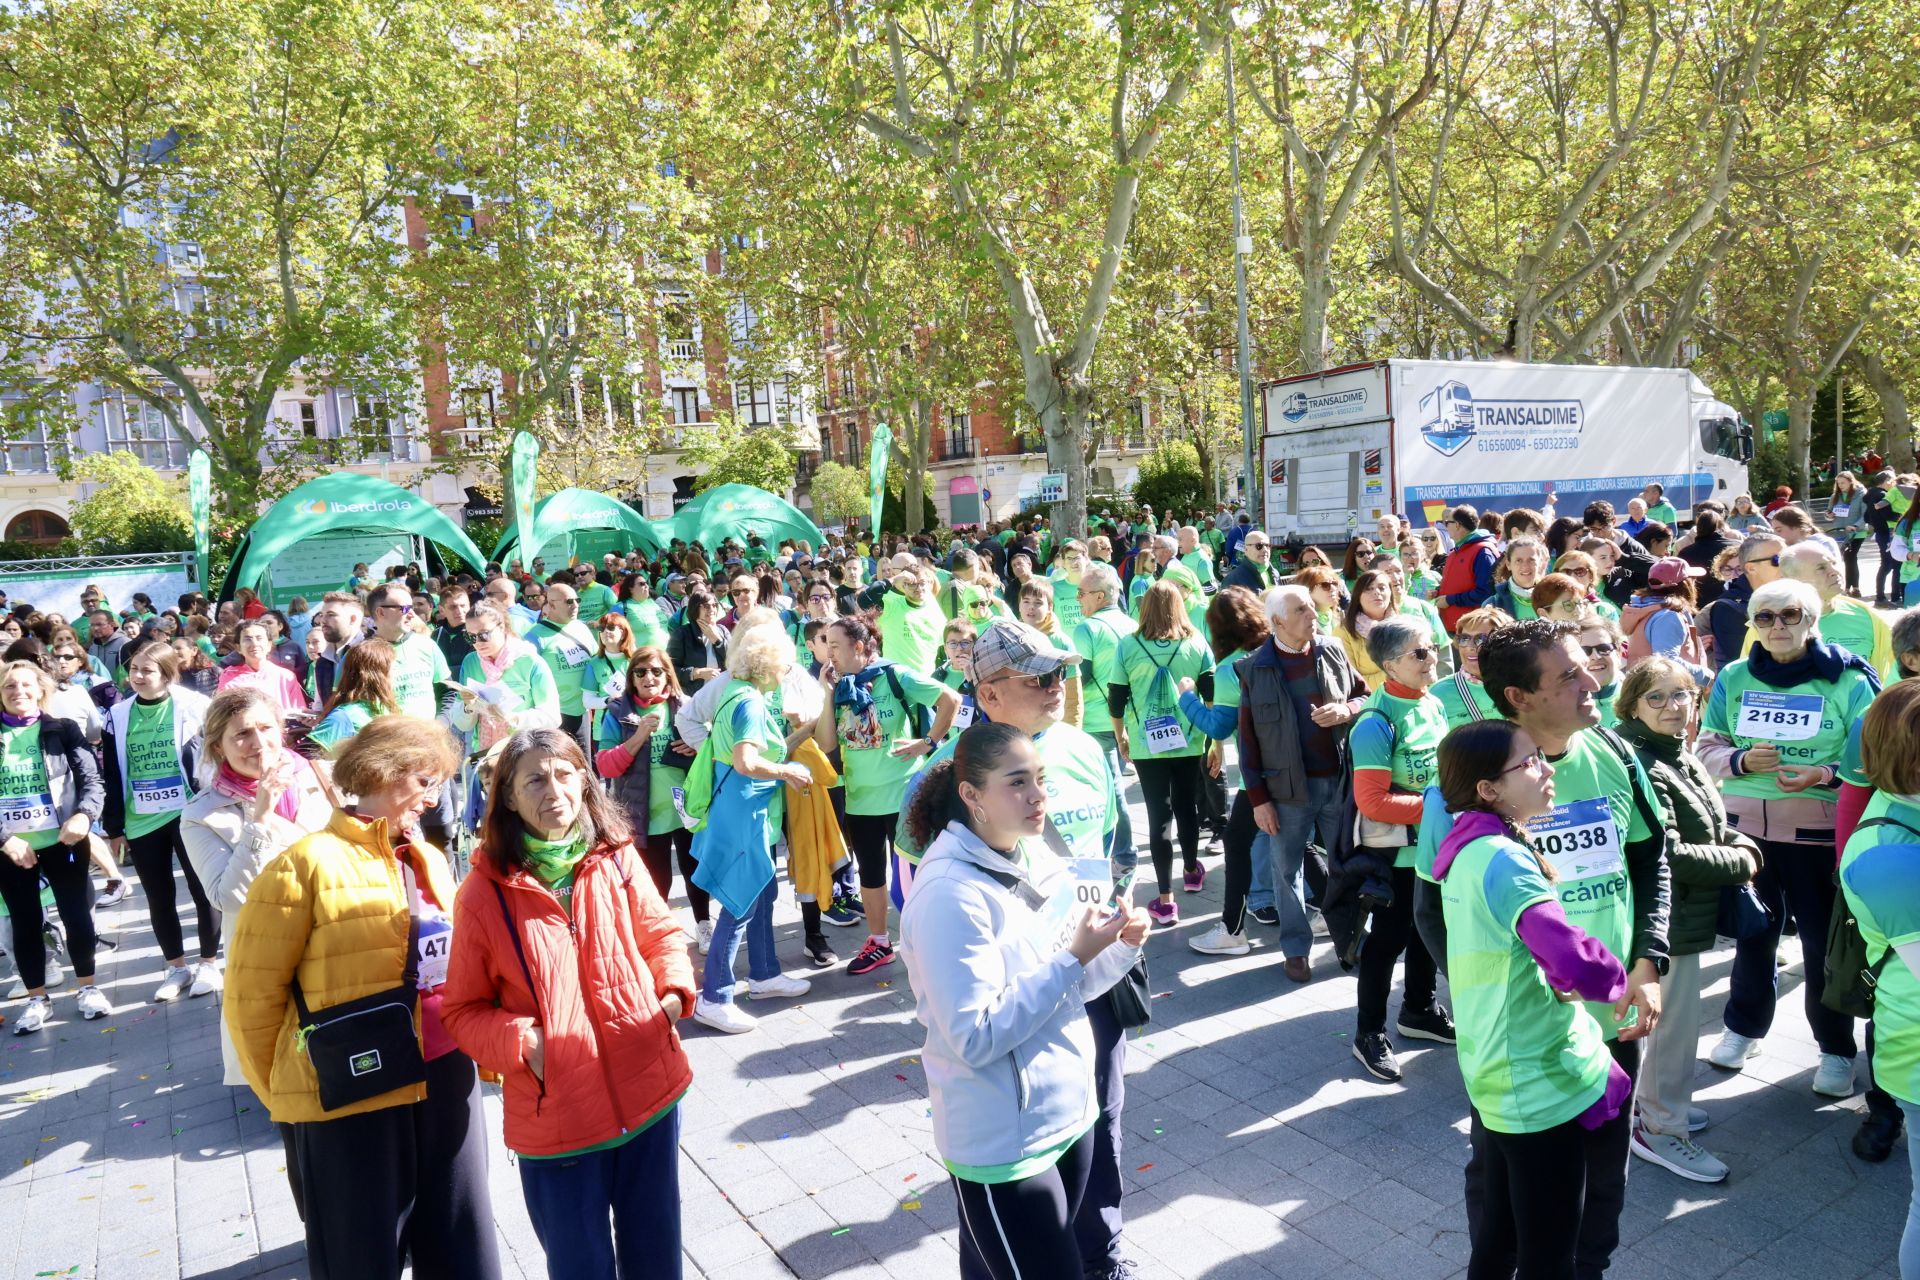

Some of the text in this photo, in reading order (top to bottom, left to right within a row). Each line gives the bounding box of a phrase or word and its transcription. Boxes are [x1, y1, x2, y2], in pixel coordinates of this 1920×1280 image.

[1309, 392, 1363, 409] TRANSALDIME
[1476, 406, 1577, 426] TRANSALDIME
[1478, 438, 1526, 452] 616560094
[1533, 436, 1579, 450] 650322390
[1415, 485, 1458, 500] TRANSPORTE
[1458, 483, 1490, 497] NACIONAL
[1490, 483, 1495, 496] E
[1495, 481, 1541, 496] INTERNACIONAL
[1555, 480, 1585, 493] TRAMPILLA
[1586, 479, 1617, 491] ELEVADORA
[1617, 478, 1640, 490] SERVICIO
[1663, 474, 1684, 486] DIRECTO
[330, 499, 412, 513] Iberdrola
[1758, 693, 1786, 701] Valladolid
[1747, 709, 1810, 726] 21831
[131, 743, 145, 753] En
[1769, 741, 1817, 759] ncer
[1415, 770, 1429, 783] el
[12, 784, 49, 795] cánc
[138, 789, 179, 803] 15035
[3, 806, 51, 821] 15036
[1551, 820, 1571, 828] cáncer
[1534, 826, 1608, 856] 40338
[418, 936, 448, 962] 47
